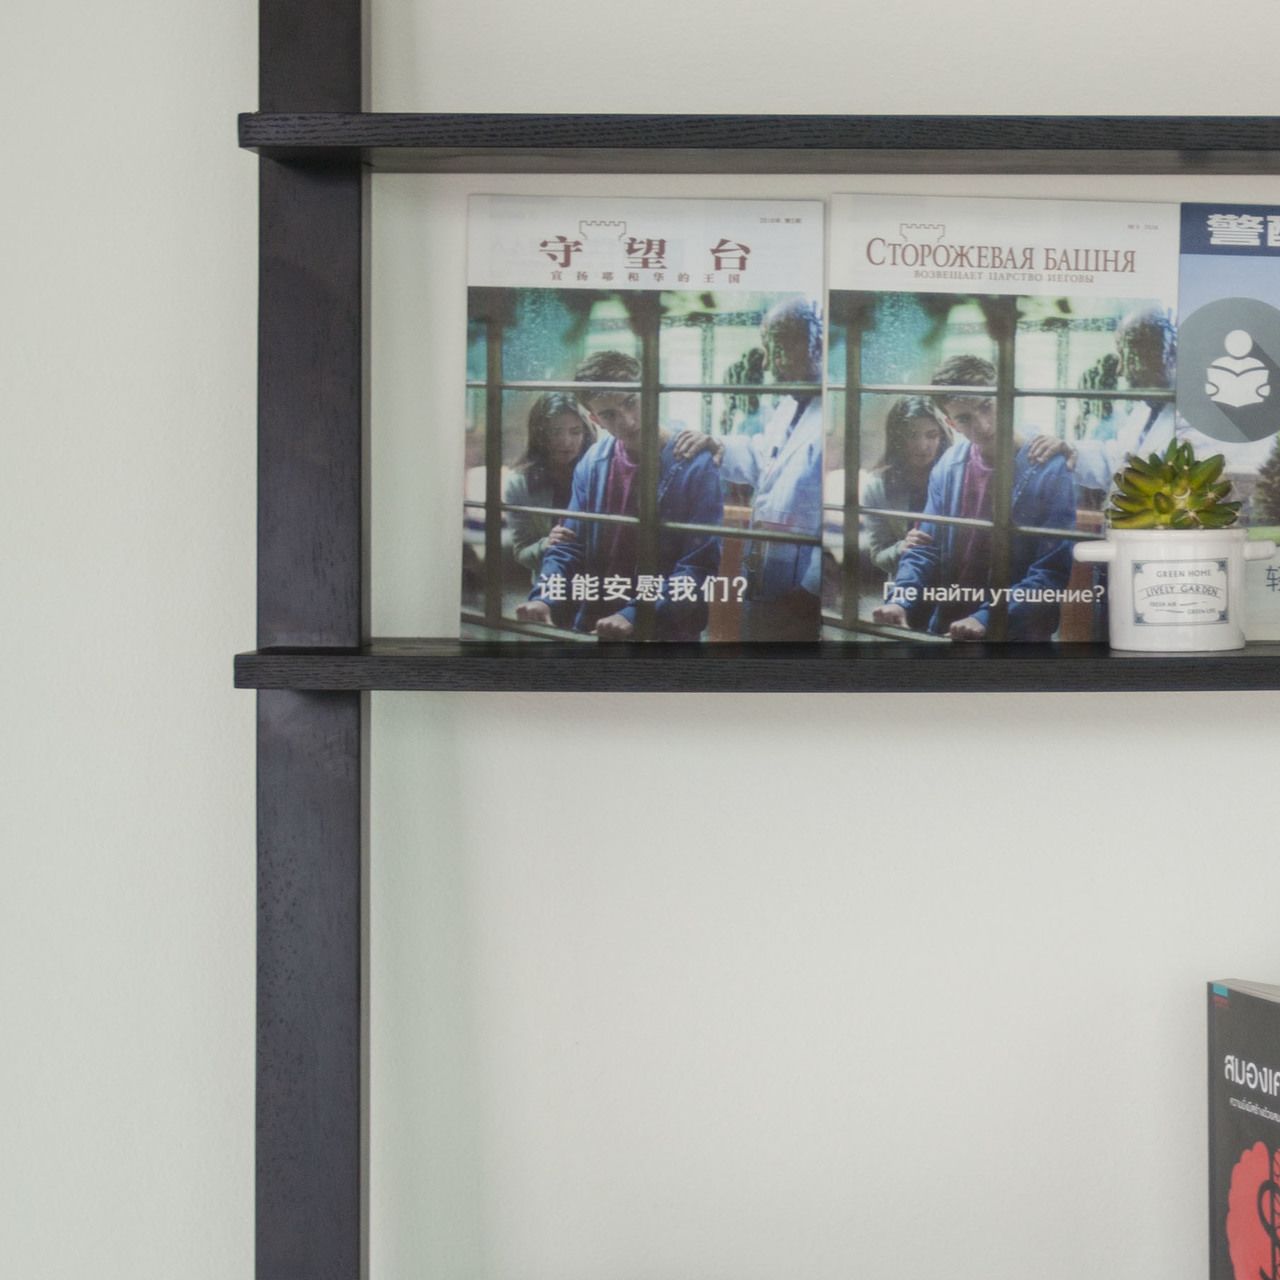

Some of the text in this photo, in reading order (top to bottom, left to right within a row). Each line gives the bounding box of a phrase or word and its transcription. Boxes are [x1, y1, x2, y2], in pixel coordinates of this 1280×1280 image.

[539, 235, 750, 271] 守望台
[1044, 247, 1136, 273] БАШНЯ
[551, 270, 741, 284] 宣扬耶和华的王国
[1156, 569, 1211, 578] GREEN HOME
[537, 574, 749, 603] 谁能安慰我们?
[883, 582, 1105, 605] Где найти утешение?
[1146, 584, 1218, 597] LIVELY GARDEN
